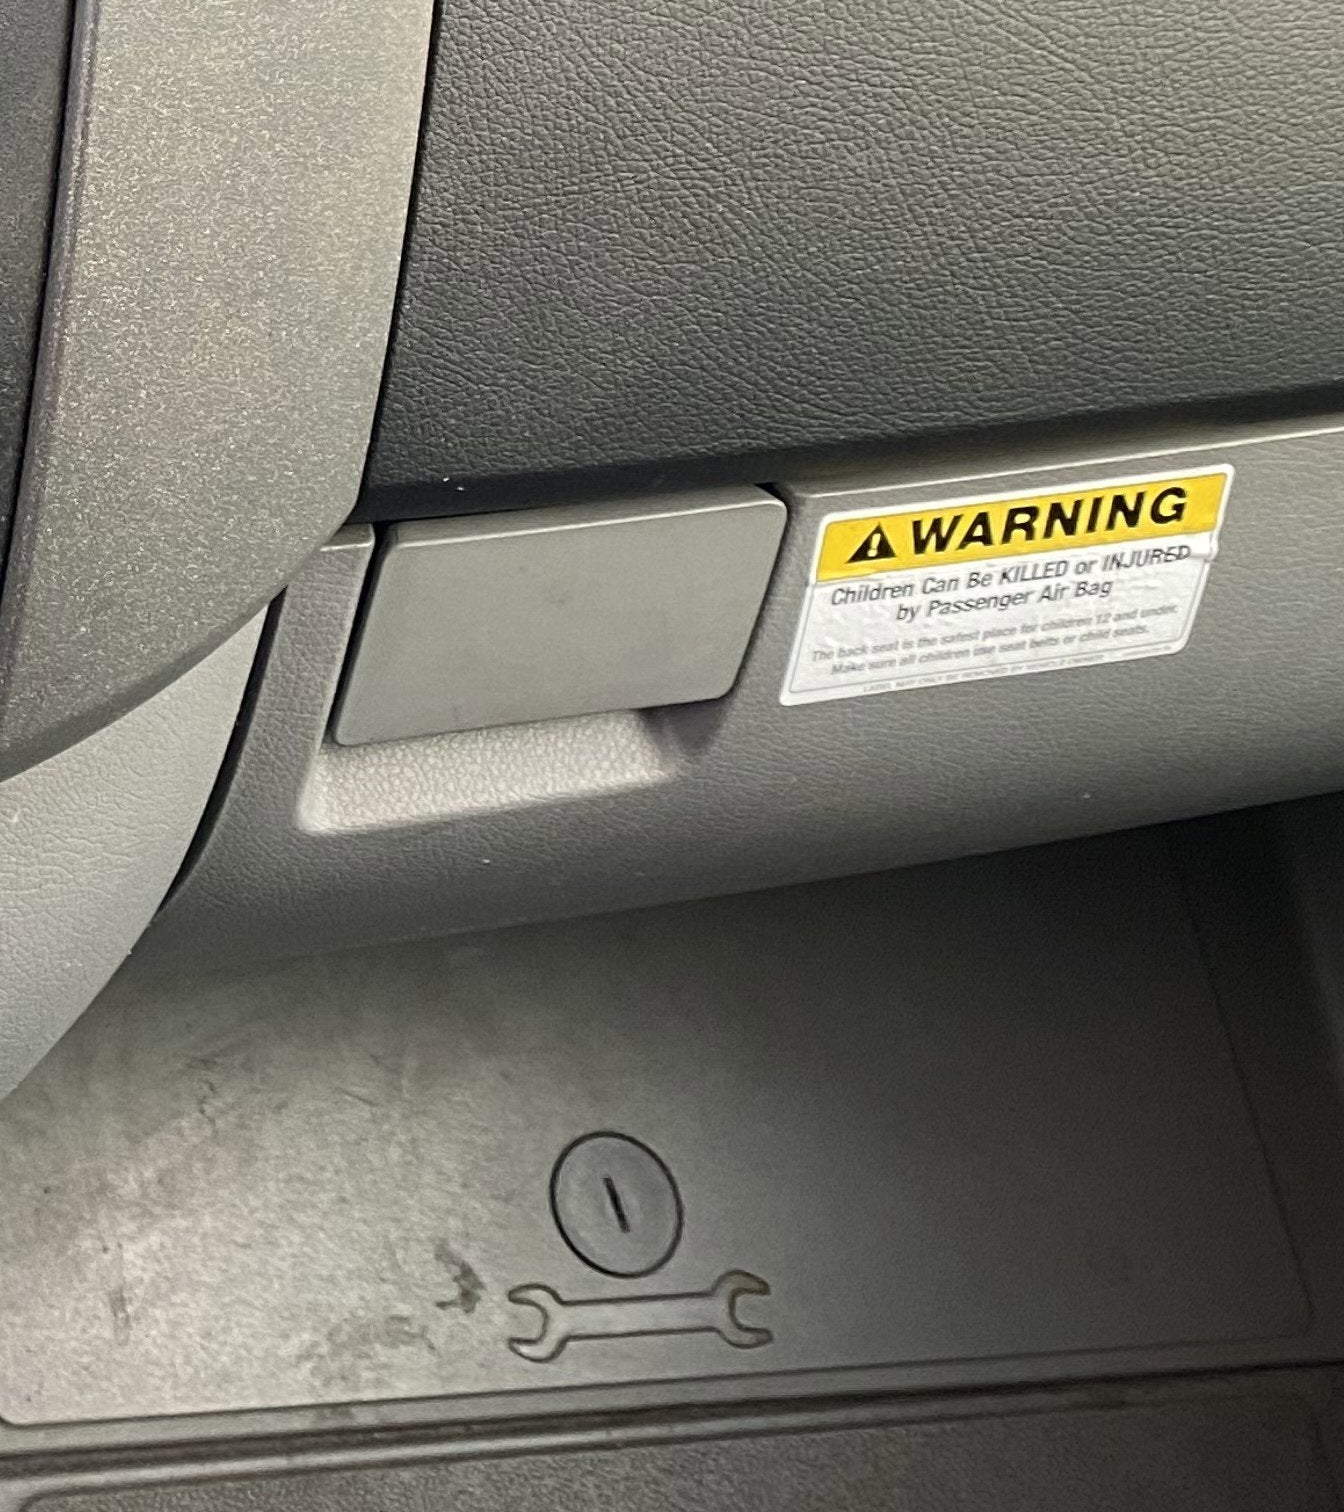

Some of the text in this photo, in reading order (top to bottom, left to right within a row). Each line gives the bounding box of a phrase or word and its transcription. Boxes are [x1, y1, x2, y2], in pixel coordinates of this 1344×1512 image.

[911, 486, 1188, 555] WARNING
[832, 545, 1191, 605] Children Can Be KILLED or INJURED
[896, 580, 1113, 623] by Passenger Air Bag
